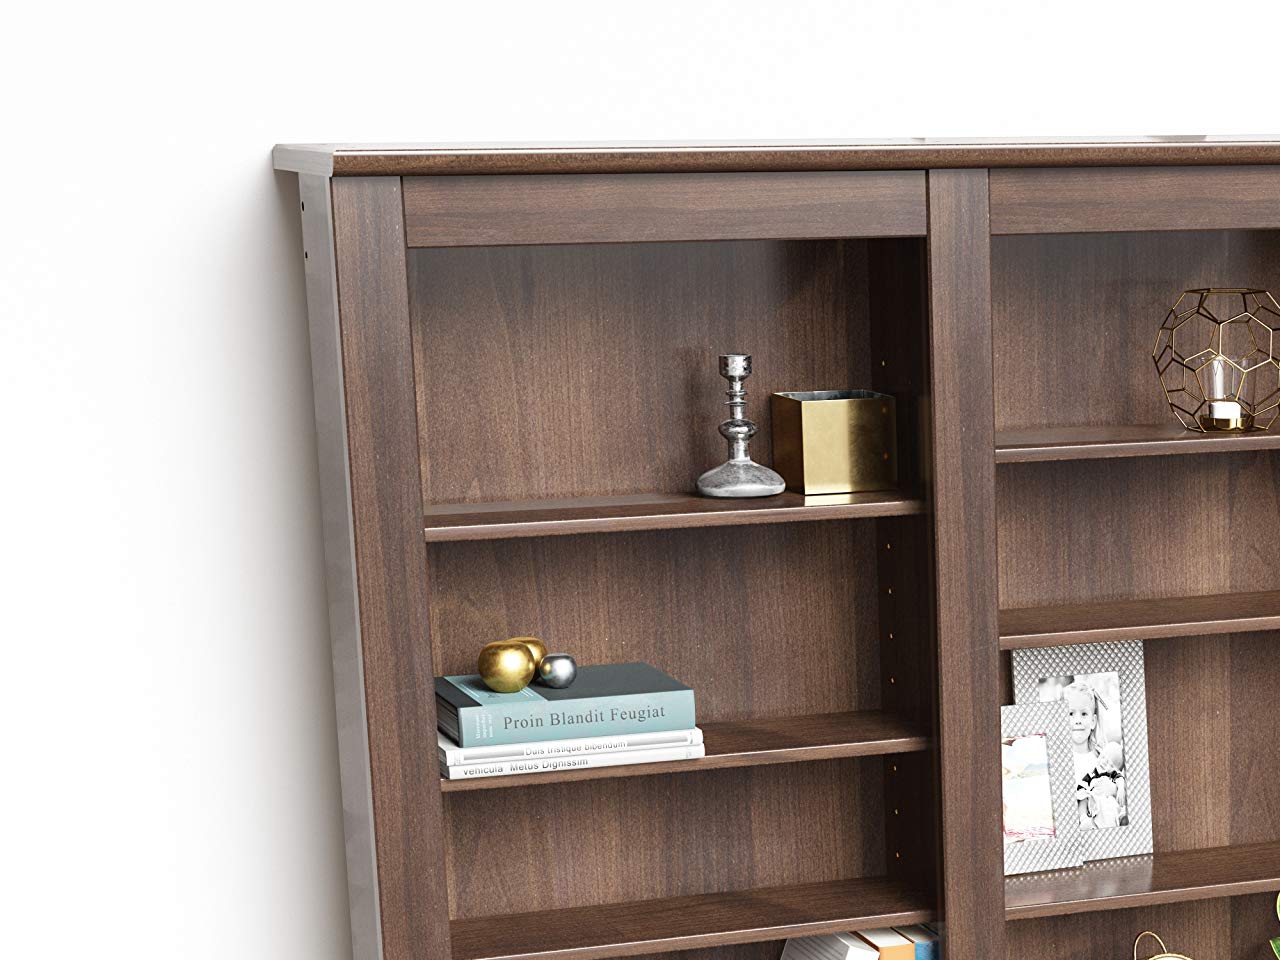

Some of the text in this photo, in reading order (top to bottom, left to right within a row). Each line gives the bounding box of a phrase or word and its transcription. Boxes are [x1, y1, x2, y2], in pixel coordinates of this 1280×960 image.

[504, 714, 544, 730] Proin
[550, 709, 605, 726] Blandit
[610, 705, 666, 722] Feugiat
[463, 759, 589, 776] vehicula Metus Dignissim
